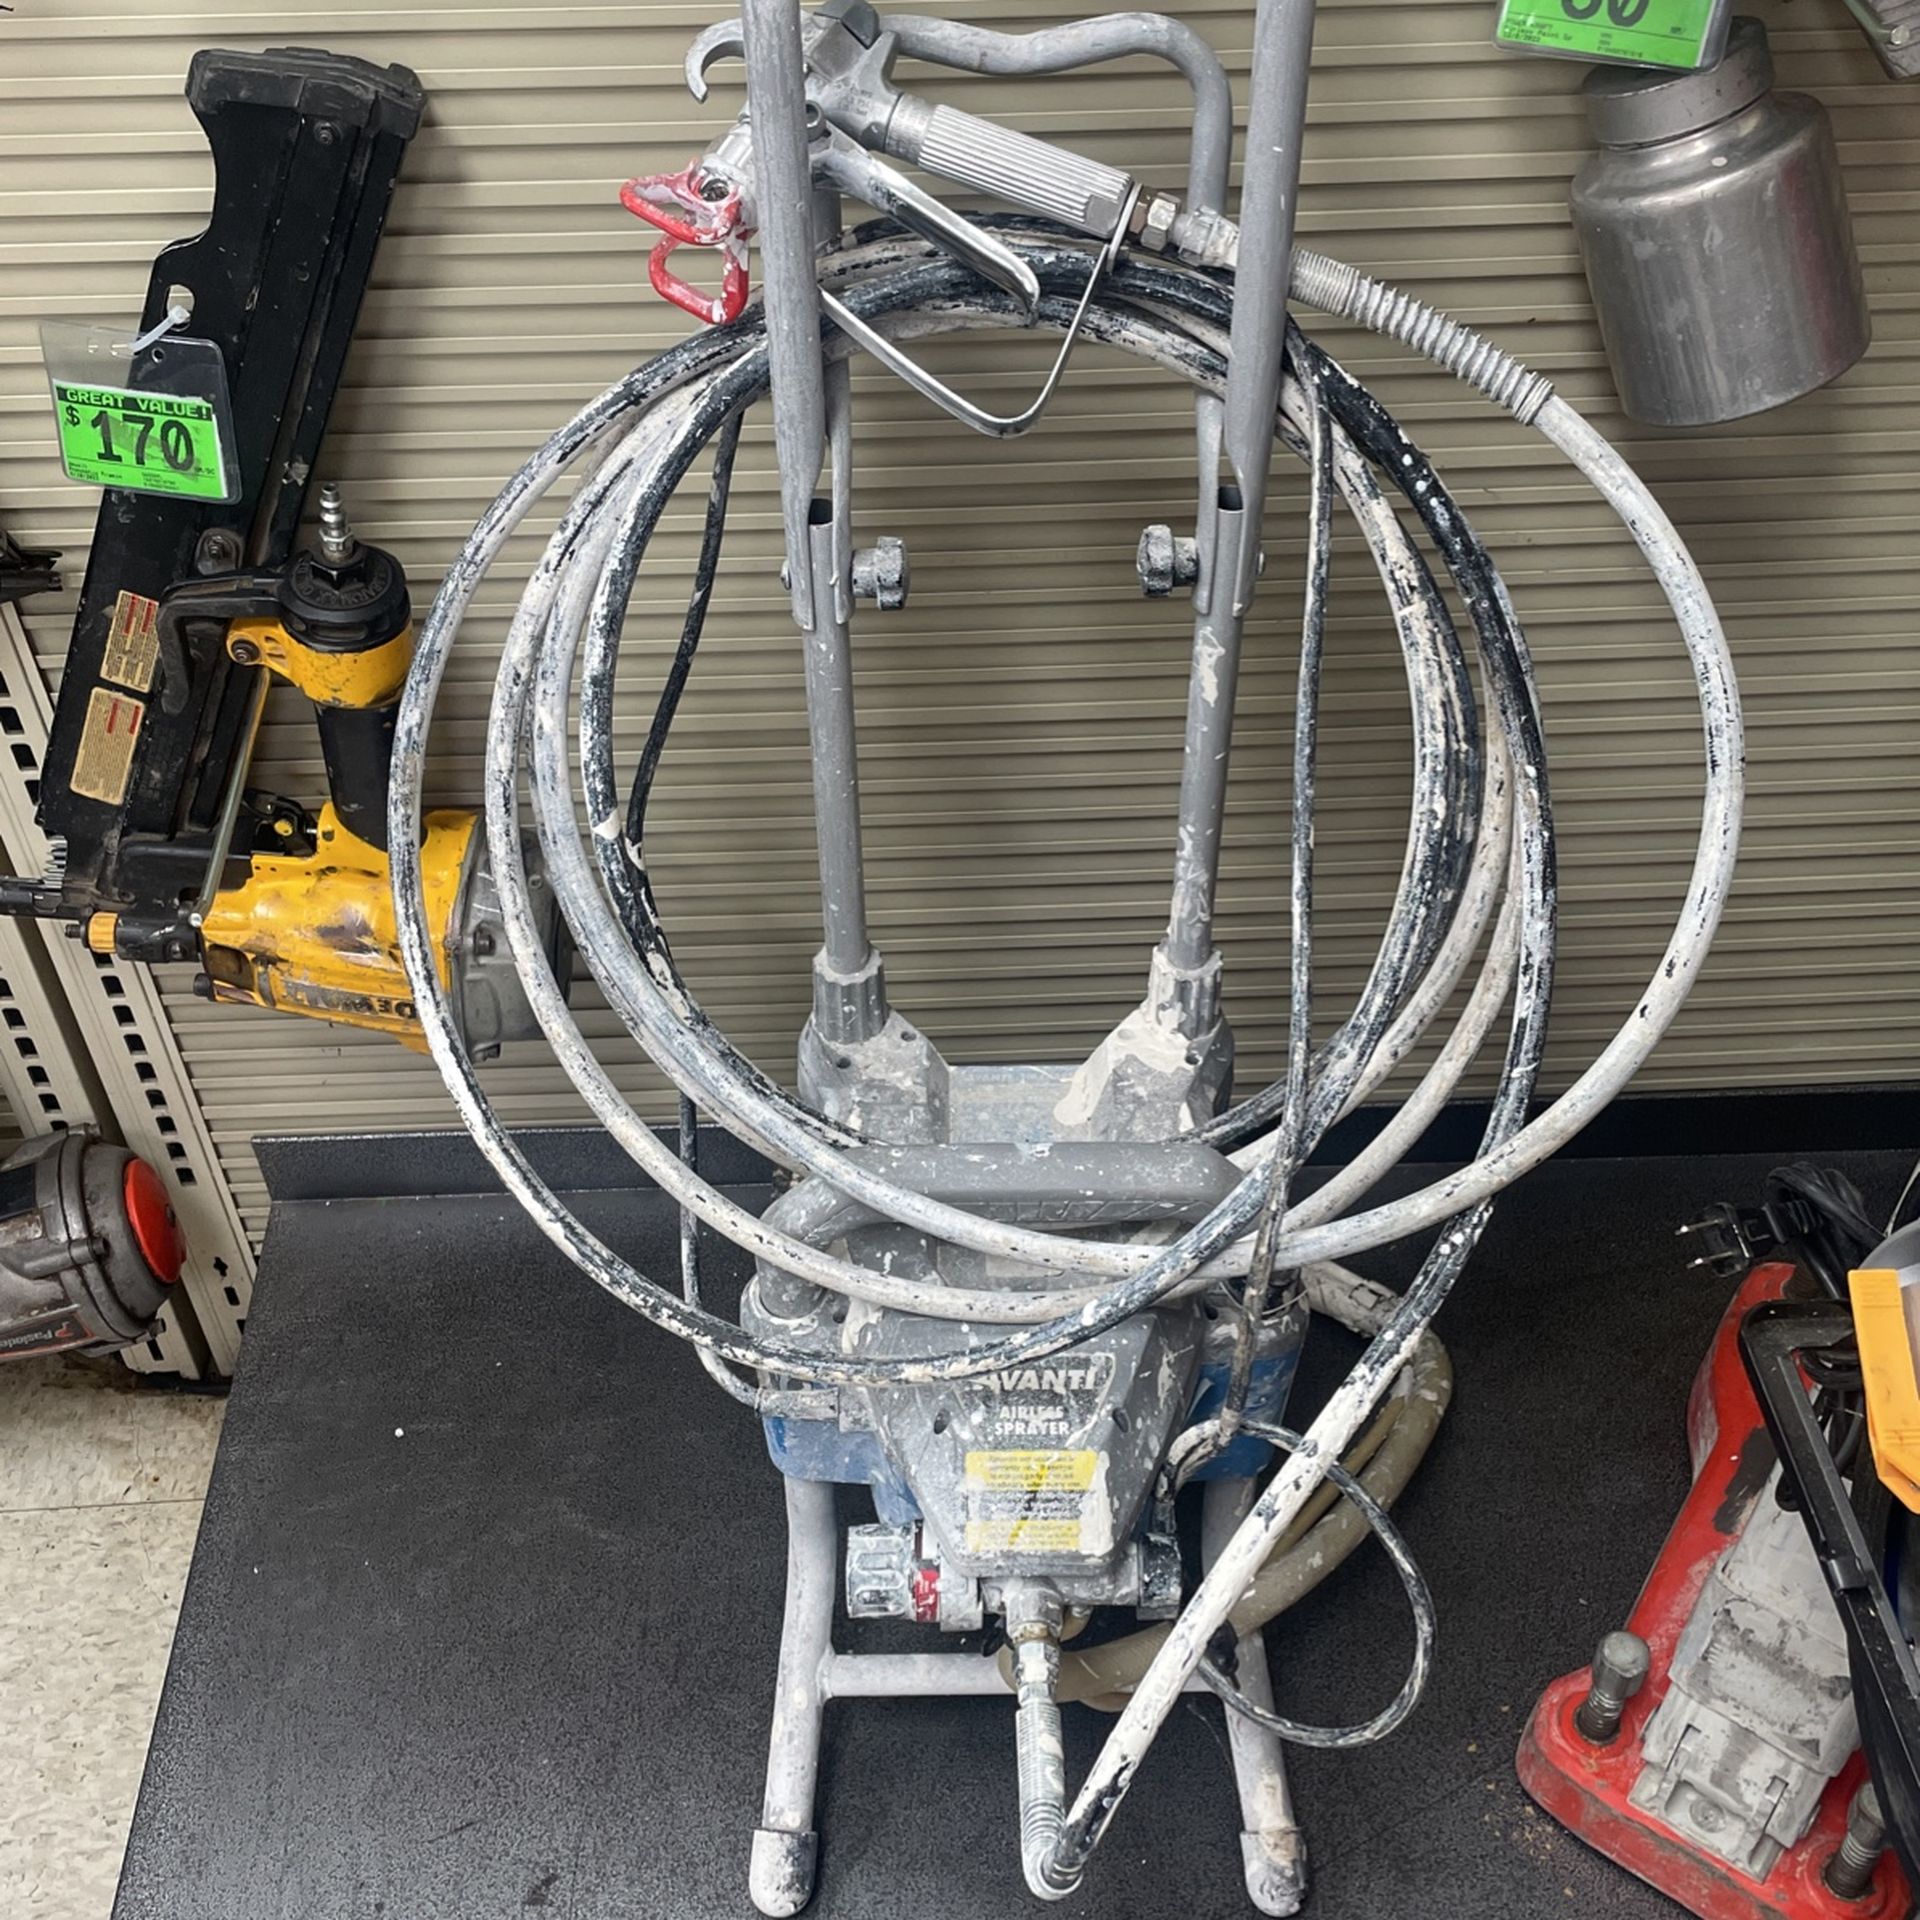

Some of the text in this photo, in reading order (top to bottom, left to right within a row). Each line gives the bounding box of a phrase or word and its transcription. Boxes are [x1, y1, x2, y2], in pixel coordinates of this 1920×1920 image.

[66, 389, 208, 419] GREAT VALUE!
[91, 410, 195, 471] 170
[0, 1329, 53, 1348] Paslode
[994, 1421, 1071, 1436] SPRAYER
